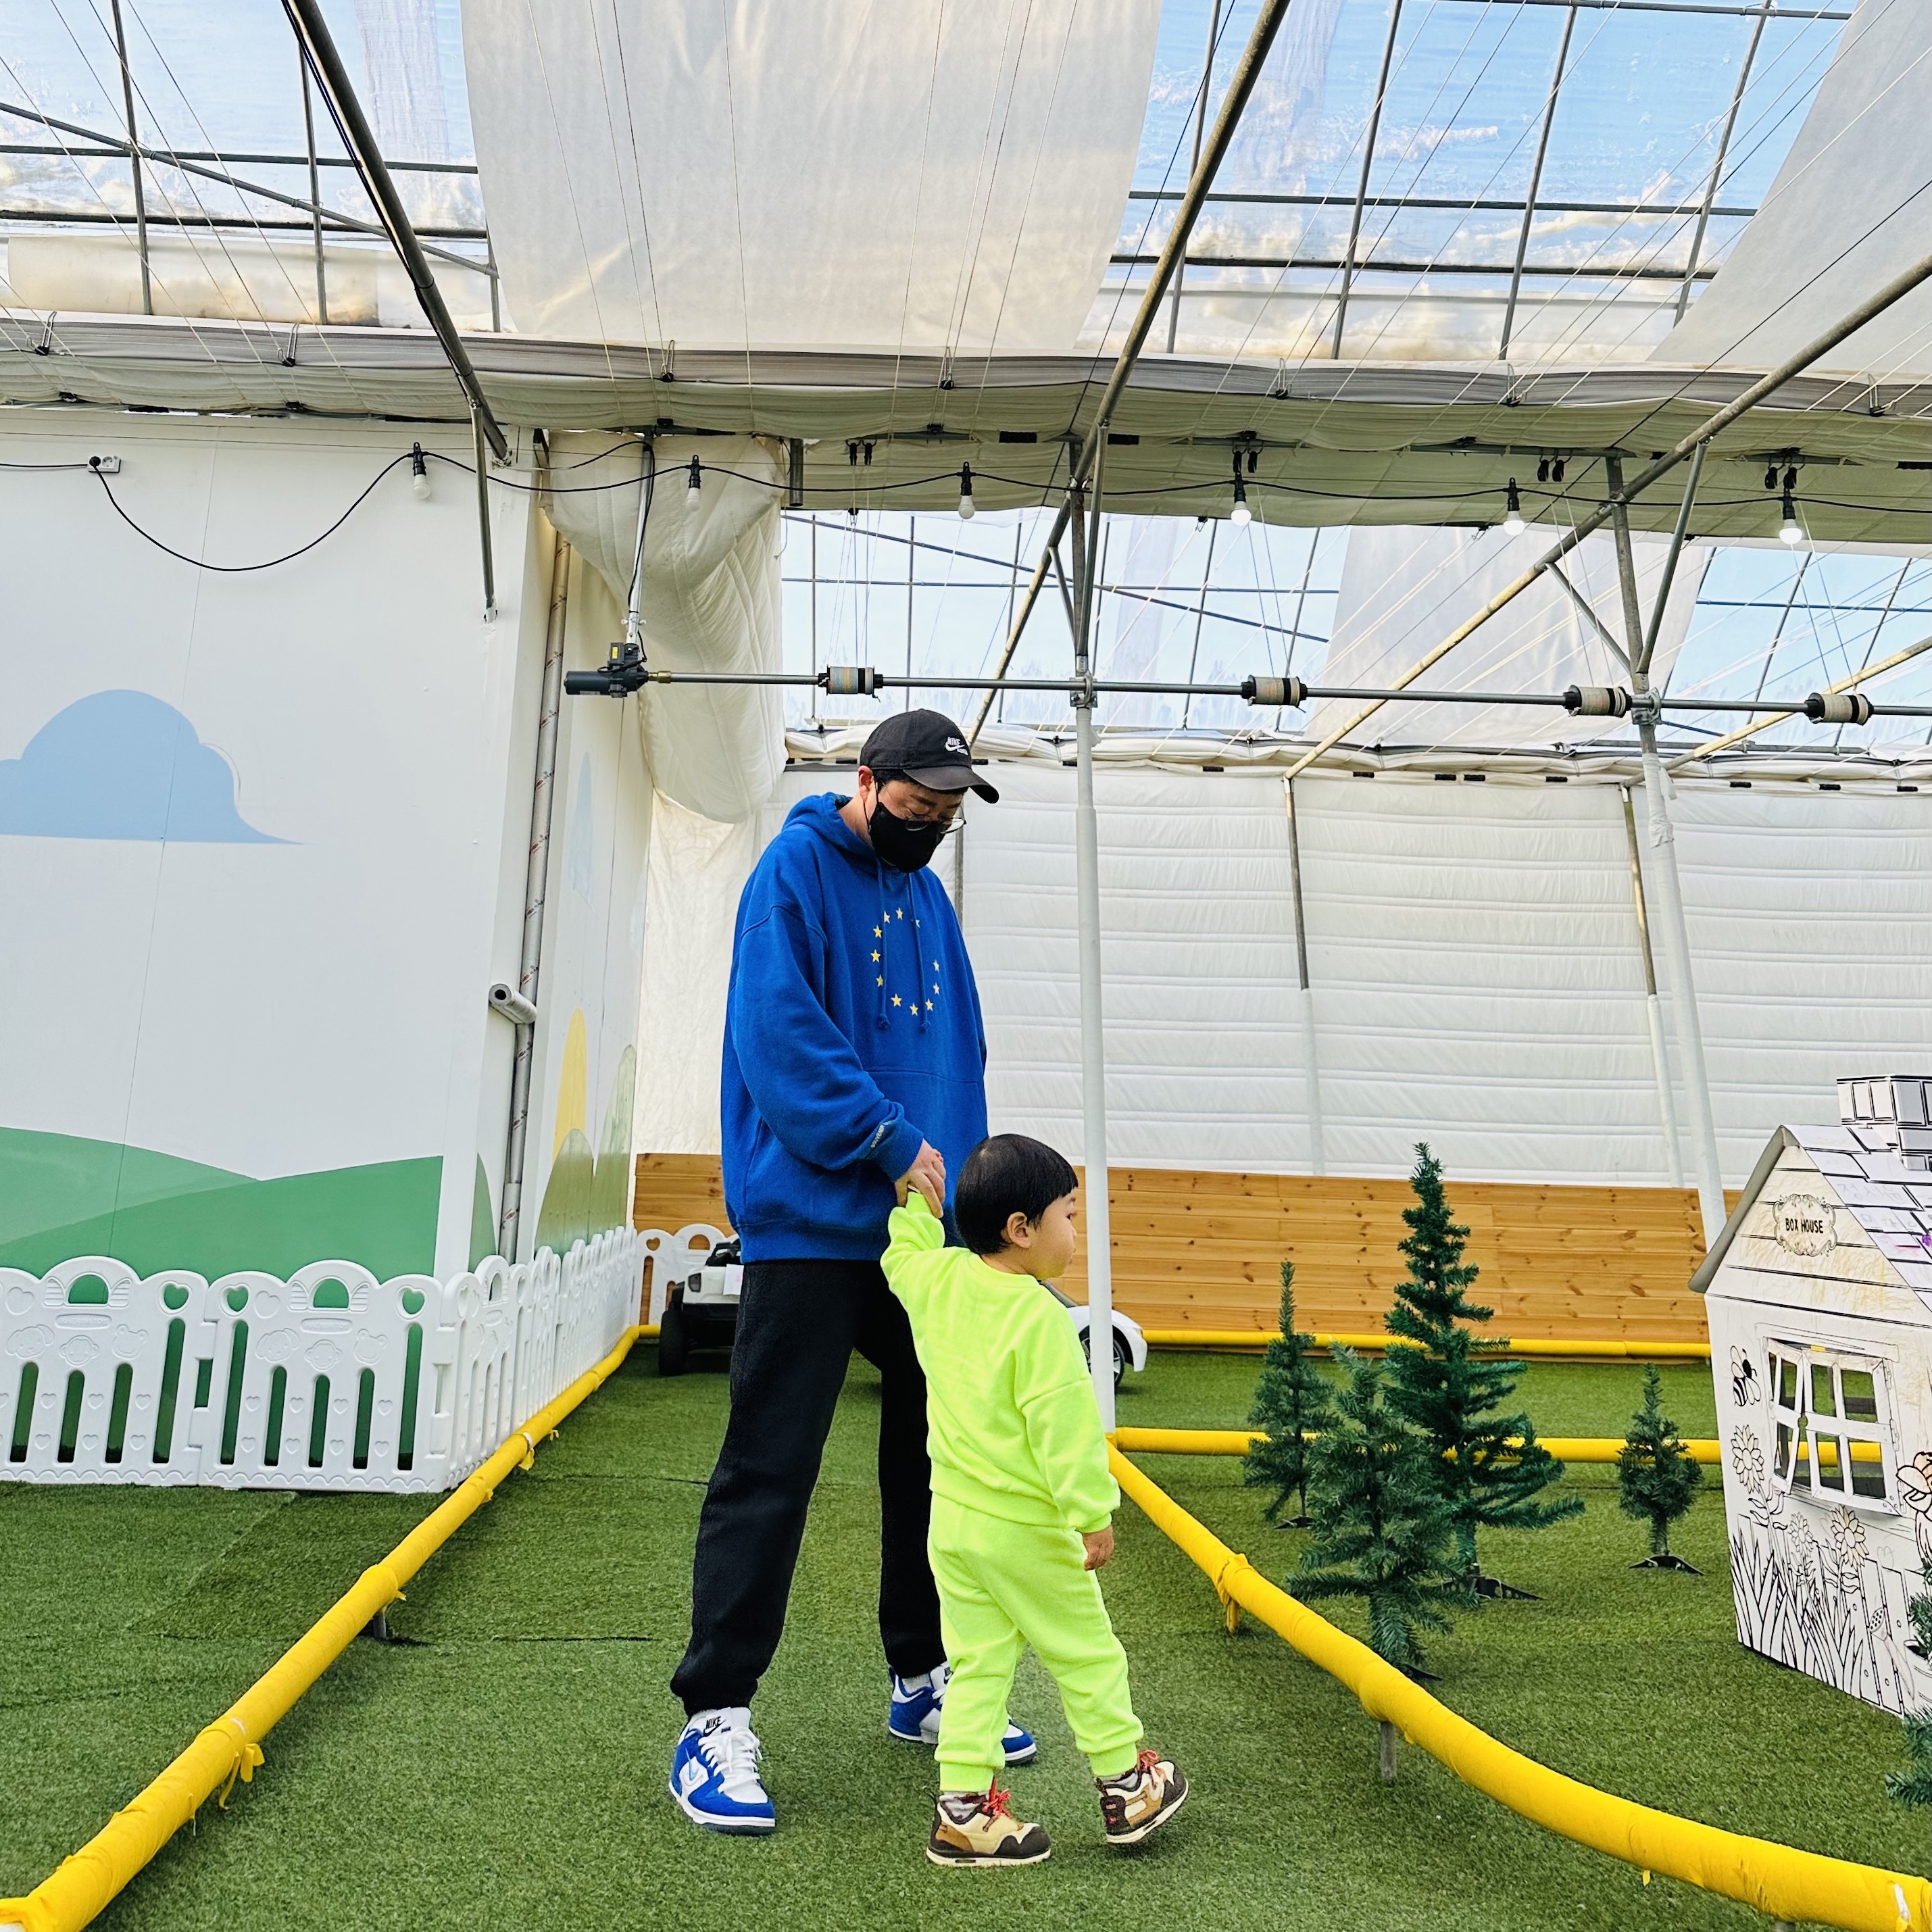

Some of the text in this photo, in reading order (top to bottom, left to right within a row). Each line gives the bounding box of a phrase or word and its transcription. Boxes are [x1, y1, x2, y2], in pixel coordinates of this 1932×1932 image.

[947, 737, 961, 745] NIKE
[1785, 1218, 1824, 1234] BOX HOUSE
[705, 1716, 721, 1729] NIKE
